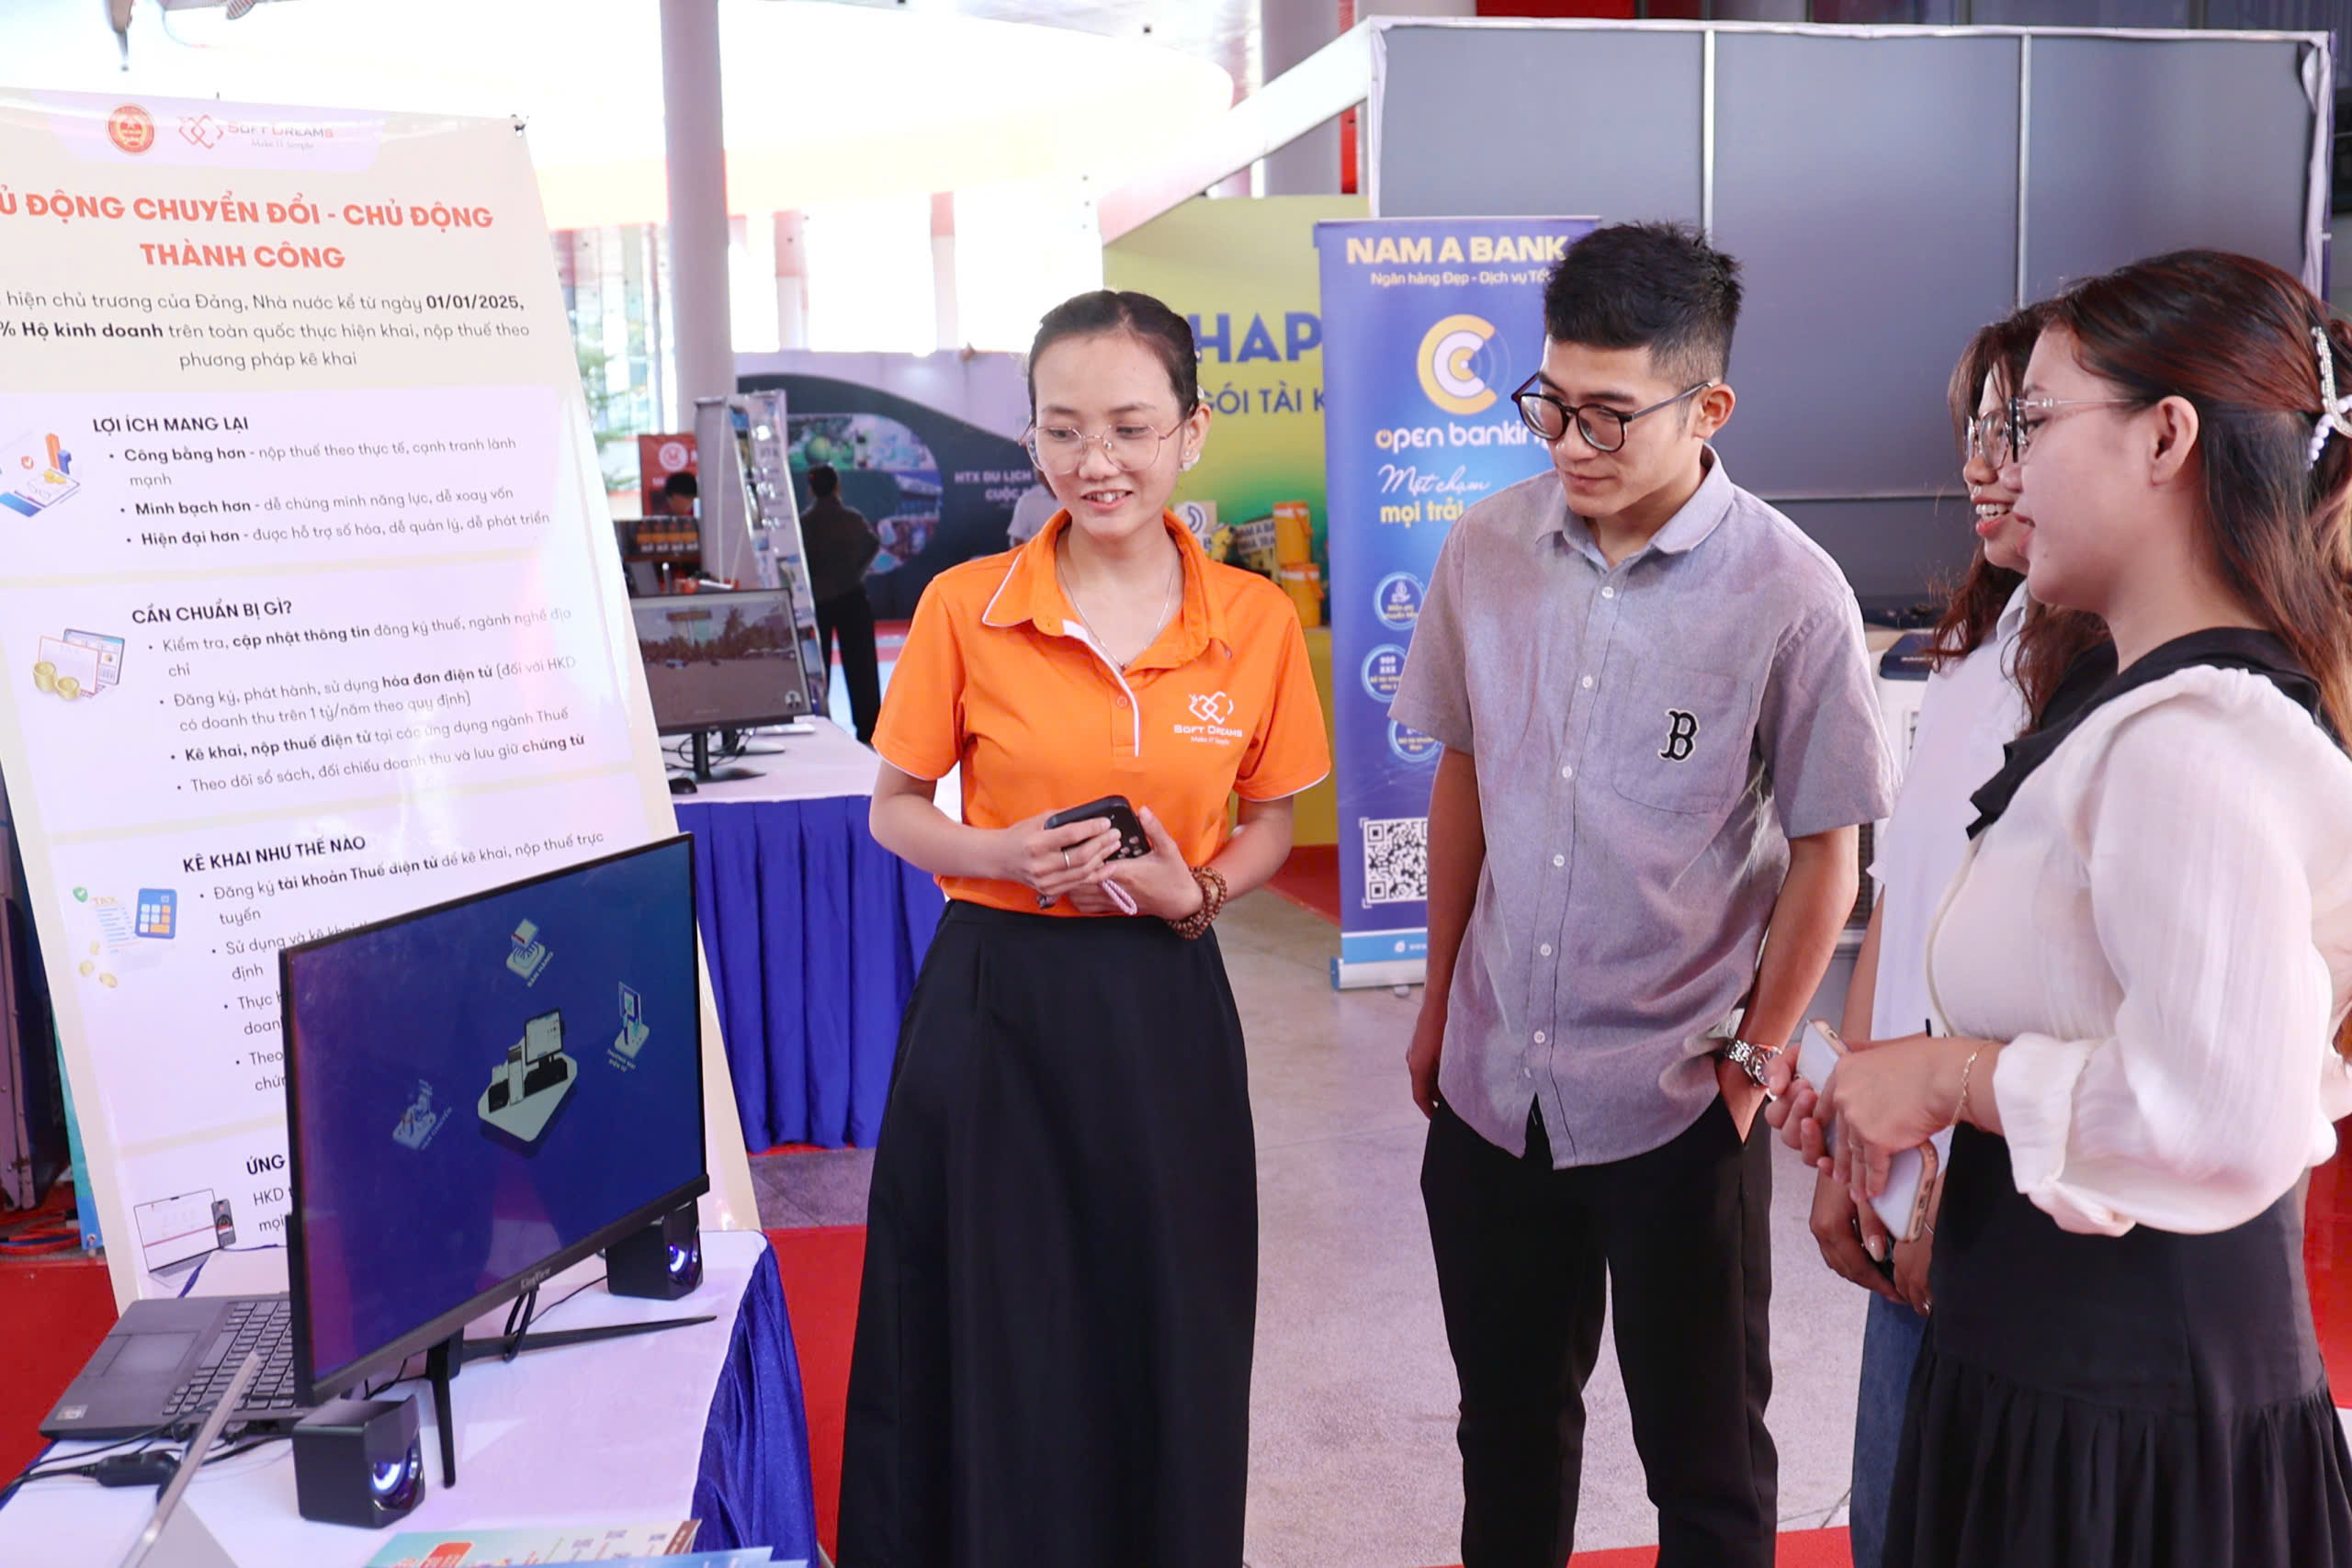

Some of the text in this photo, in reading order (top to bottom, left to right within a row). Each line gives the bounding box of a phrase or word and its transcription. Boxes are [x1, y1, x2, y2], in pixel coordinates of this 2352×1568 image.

[26, 189, 125, 223] ĐỘNG
[133, 191, 259, 222] CHUYỂN
[266, 193, 320, 224] ĐỔI
[344, 198, 403, 226] CHỦ
[410, 201, 492, 232] ĐỘNG
[140, 239, 345, 268] THÀNH CÔNG
[1346, 234, 1568, 265] NAM A BANK
[1371, 272, 1408, 287] Ngân
[1408, 271, 1442, 287] hàng
[1442, 271, 1470, 288] Đẹp
[1479, 270, 1510, 286] Dịch
[1511, 273, 1527, 286] vụ
[6, 290, 524, 314] hiện chủ trương của Đảng, Nhà nước kể từ ngày 01/01/2025,
[22, 321, 529, 343] Hộ kinh doanh trên toàn quốc thực hiện khai, nộp thuế theo
[179, 351, 356, 371] phương pháp kê khai
[1259, 378, 1302, 413] TÀI
[93, 416, 248, 435] LỢI ÍCH MANG LẠI
[125, 449, 168, 464] Công
[172, 447, 213, 463] bằng
[217, 447, 245, 459] hơn
[259, 446, 286, 462] nộp
[289, 444, 320, 457] thuế
[324, 444, 355, 456] theo
[358, 443, 389, 457] thực
[413, 441, 446, 456] cạnh
[449, 438, 484, 452] tranh
[487, 437, 515, 449] lành
[1375, 426, 1445, 455] open
[130, 472, 172, 489] mạnh
[955, 470, 980, 483] HTX
[982, 470, 1001, 482] DU
[135, 501, 251, 516] Minh bạch hơn
[1380, 495, 1464, 528] mọi trải
[141, 531, 239, 547] Hiện đại hơn
[132, 598, 291, 624] CẦN CHUẨN BỊ GÌ?
[163, 637, 198, 652] Kiểm
[232, 635, 261, 649] cập
[266, 632, 300, 646] nhật
[304, 629, 347, 642] thông
[351, 626, 369, 637] tin
[374, 625, 409, 638] đăng
[413, 621, 428, 636] ký
[432, 617, 465, 631] thuế,
[469, 613, 511, 631] ngành
[169, 662, 190, 677] chỉ
[175, 694, 214, 708] Đăng
[244, 687, 277, 705] phát
[280, 683, 321, 697] hành,
[324, 680, 340, 694] sử
[344, 680, 379, 694] dụng
[382, 676, 409, 688] hóa
[413, 673, 440, 684] đơn
[444, 670, 474, 682] điện
[478, 665, 492, 678] tử
[186, 706, 568, 761] Kê khai, nộp thuế điện tử tại dụng ngành Thuế
[1173, 724, 1205, 735] SOFT
[1657, 708, 1700, 763] B
[523, 735, 584, 752] chứng từ
[183, 836, 366, 873] KÊ KHAI NHƯ THẾ NÀO
[214, 833, 604, 899] Đăng ký tài khoản Thuế điện tử để kê khai, nộp thuế trực
[220, 907, 261, 927] tuyến
[226, 941, 244, 955] Sử
[249, 936, 286, 952] dụng
[232, 964, 264, 981] định
[237, 996, 272, 1010] Thực
[250, 1052, 283, 1065] Theo
[246, 1155, 285, 1175] ỨNG
[254, 1188, 284, 1205] HKD
[259, 1214, 284, 1232] mọi
